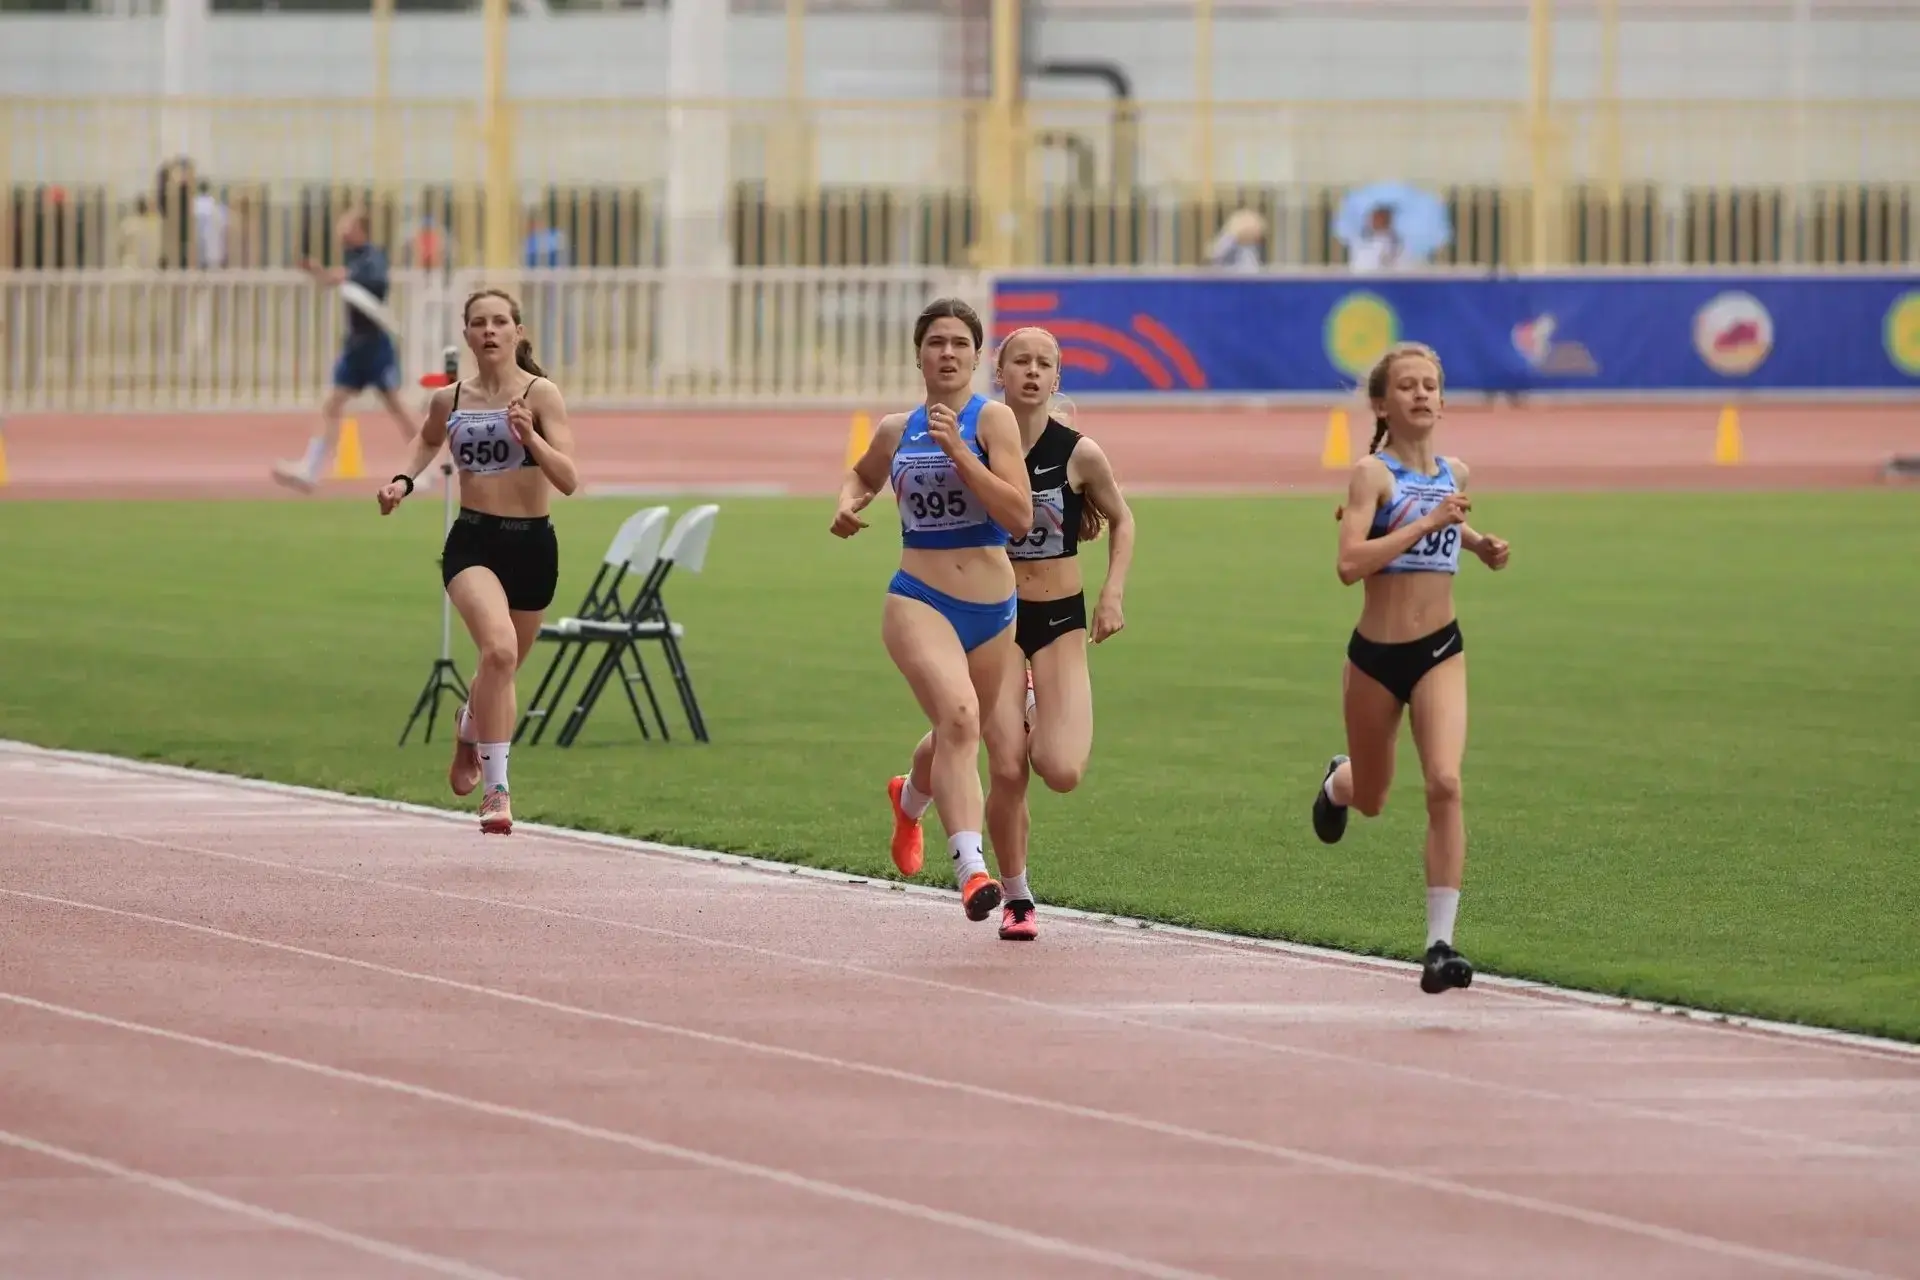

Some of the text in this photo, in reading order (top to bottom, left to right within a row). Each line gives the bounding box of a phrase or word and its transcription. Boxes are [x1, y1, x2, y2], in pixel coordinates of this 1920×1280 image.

[460, 440, 509, 464] 550
[910, 490, 967, 519] 395
[500, 520, 532, 530] NIKE
